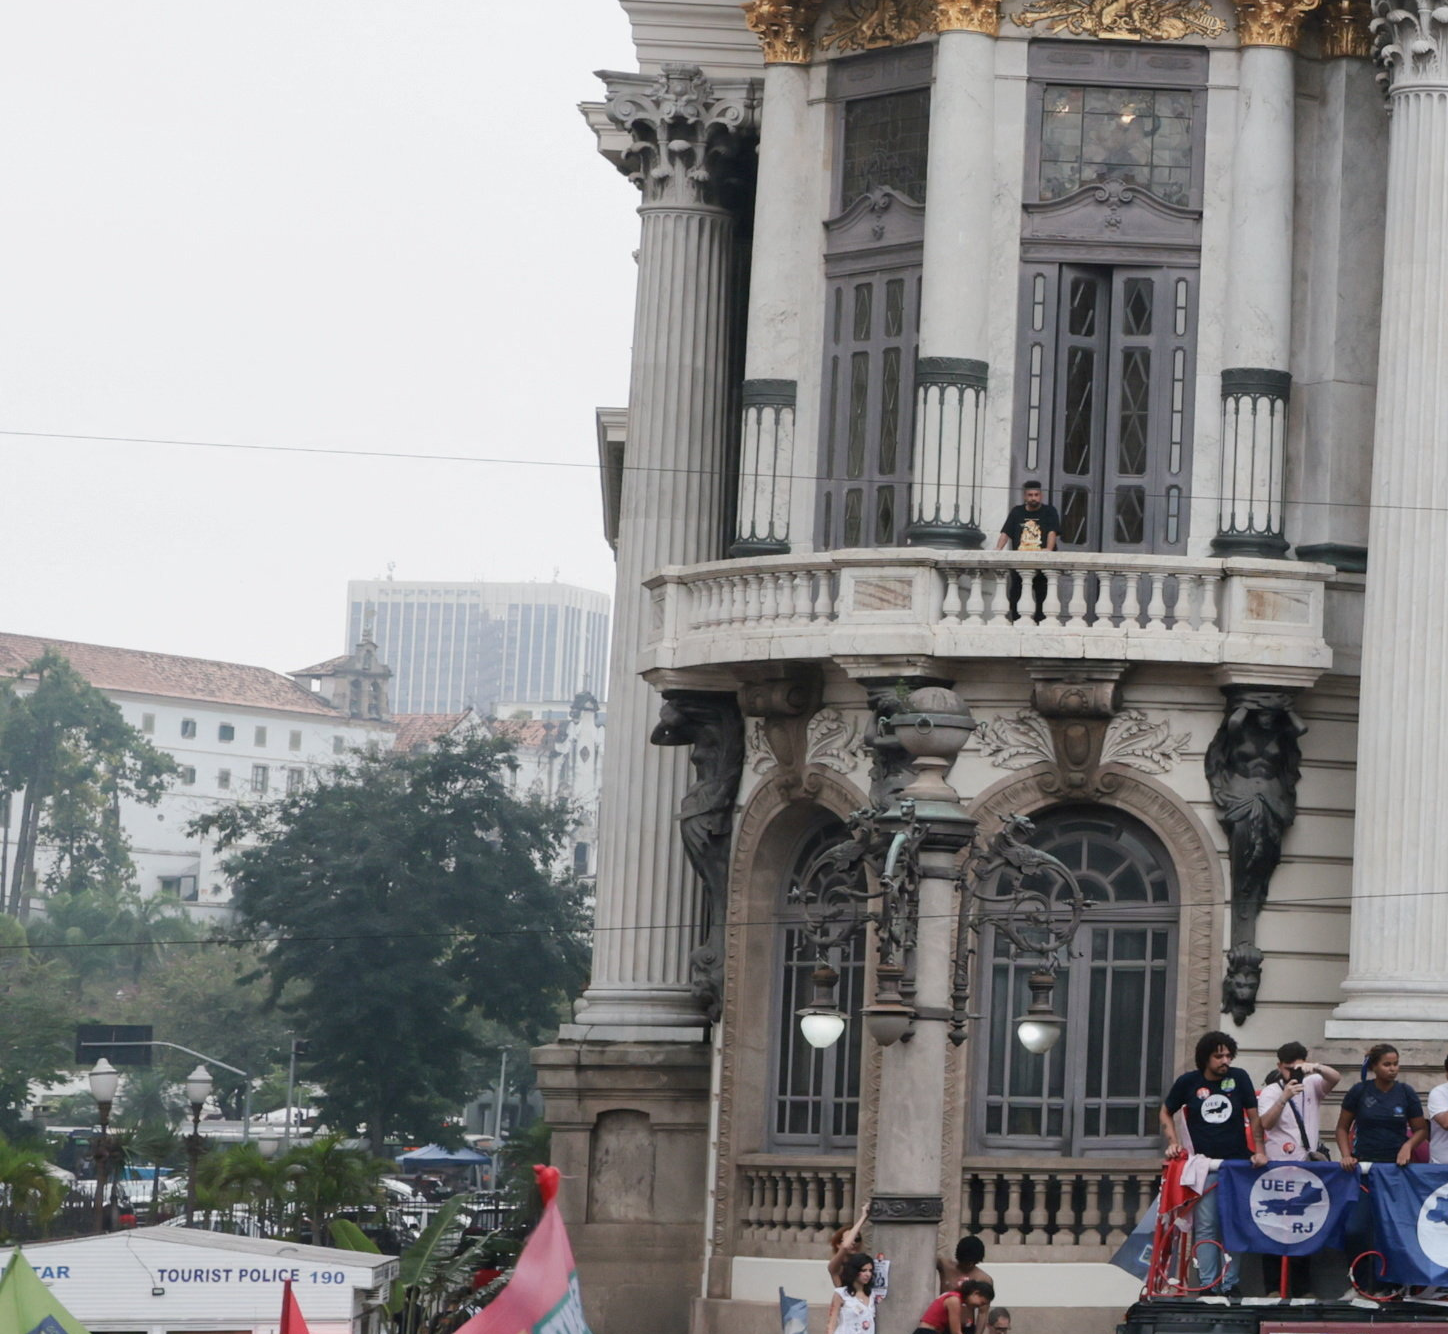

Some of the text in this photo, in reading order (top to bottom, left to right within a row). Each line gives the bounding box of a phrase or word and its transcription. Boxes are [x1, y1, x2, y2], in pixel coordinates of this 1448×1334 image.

[1261, 1179, 1295, 1193] UEE
[1292, 1222, 1314, 1235] RJ
[157, 1268, 345, 1285] TOURIST POLICE 190
